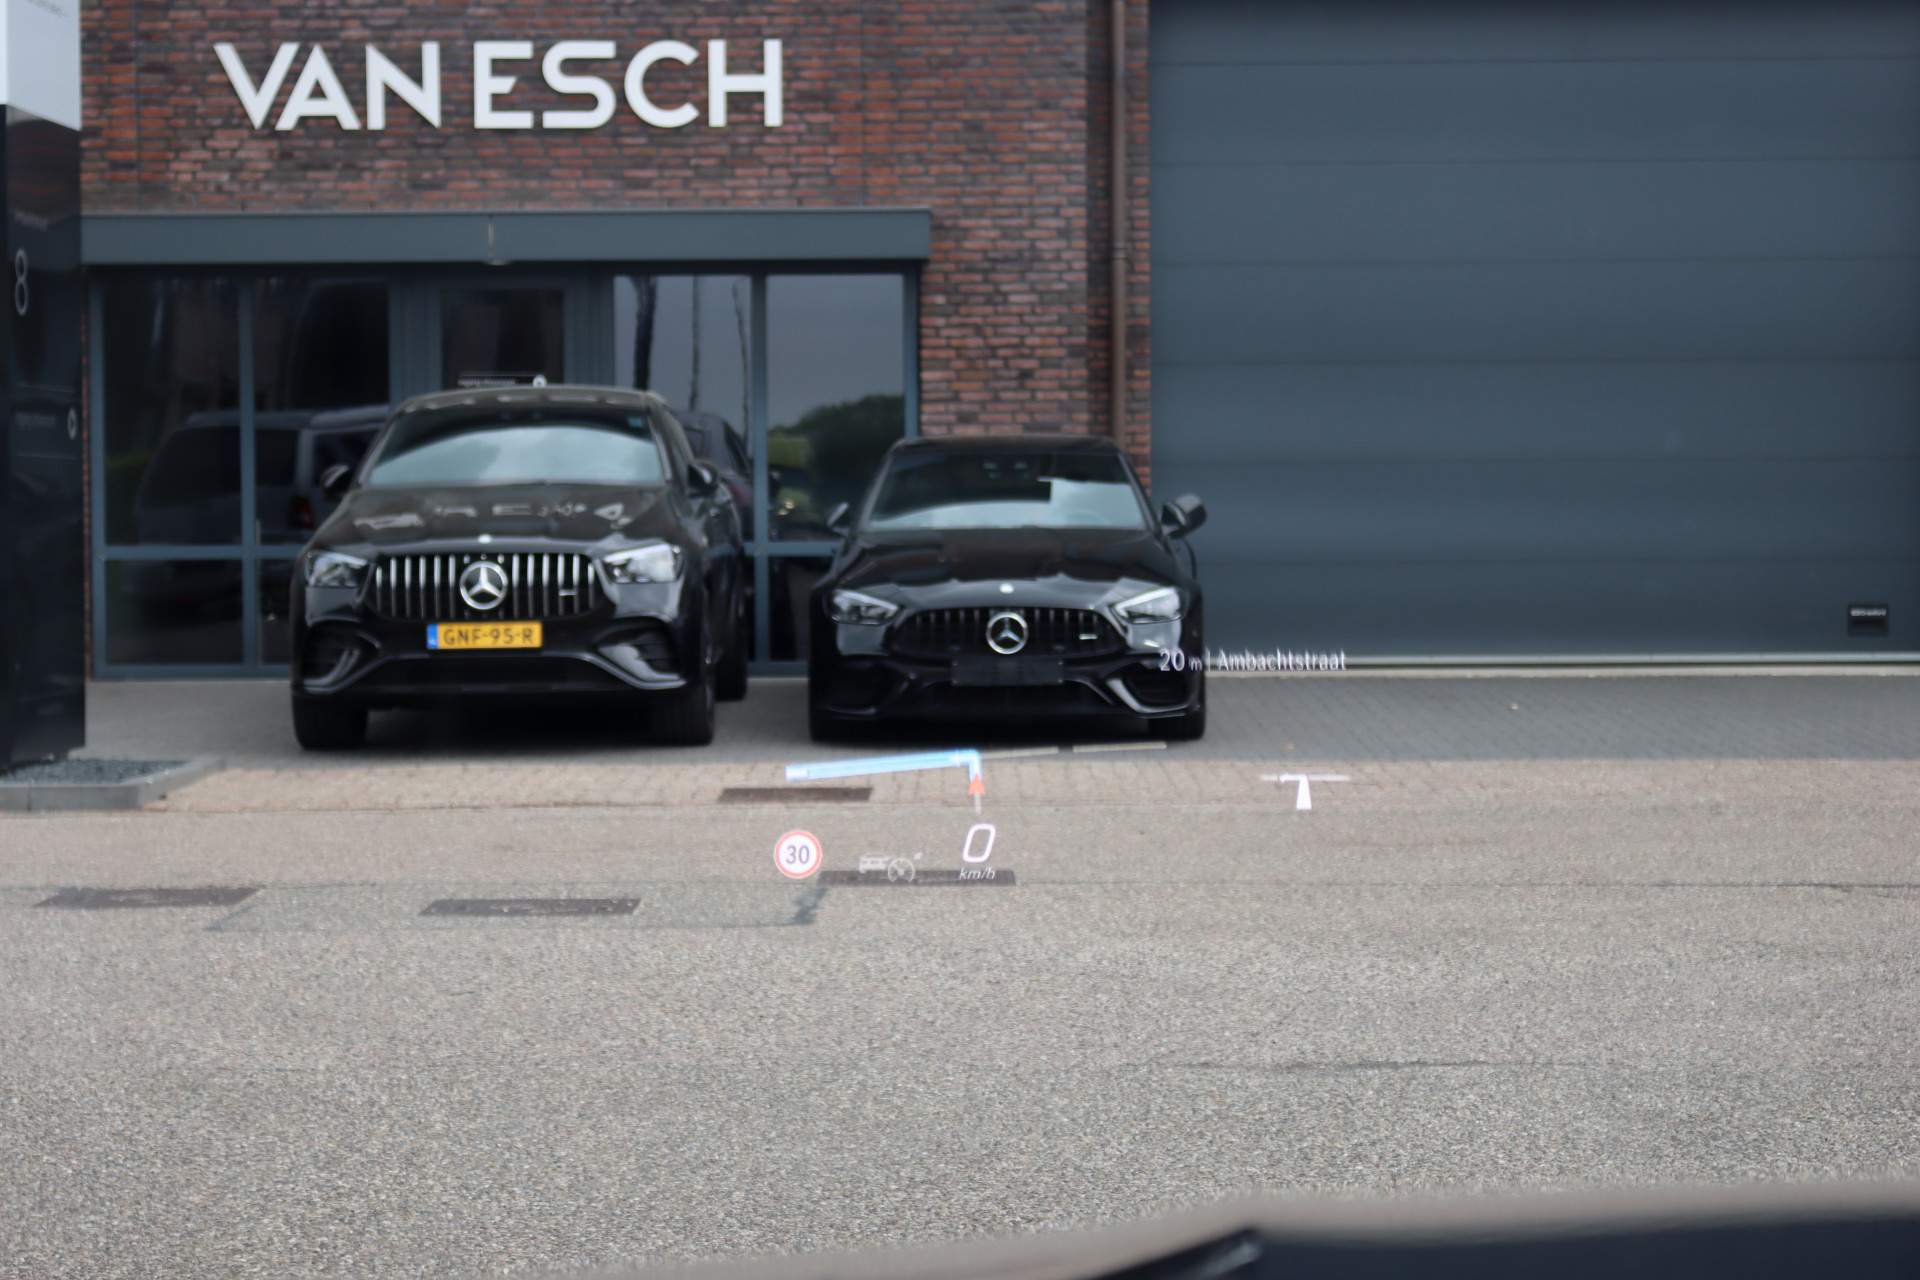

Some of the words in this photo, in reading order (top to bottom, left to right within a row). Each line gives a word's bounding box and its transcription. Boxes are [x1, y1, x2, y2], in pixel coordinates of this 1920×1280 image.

[213, 41, 442, 131] VAN
[473, 39, 783, 129] ESCH
[443, 627, 534, 646] GNF-95-R
[1160, 649, 1185, 671] 20
[1218, 648, 1346, 671] Ambachtstraat
[962, 823, 996, 863] 0
[785, 844, 810, 865] 30
[959, 866, 996, 881] km/h
